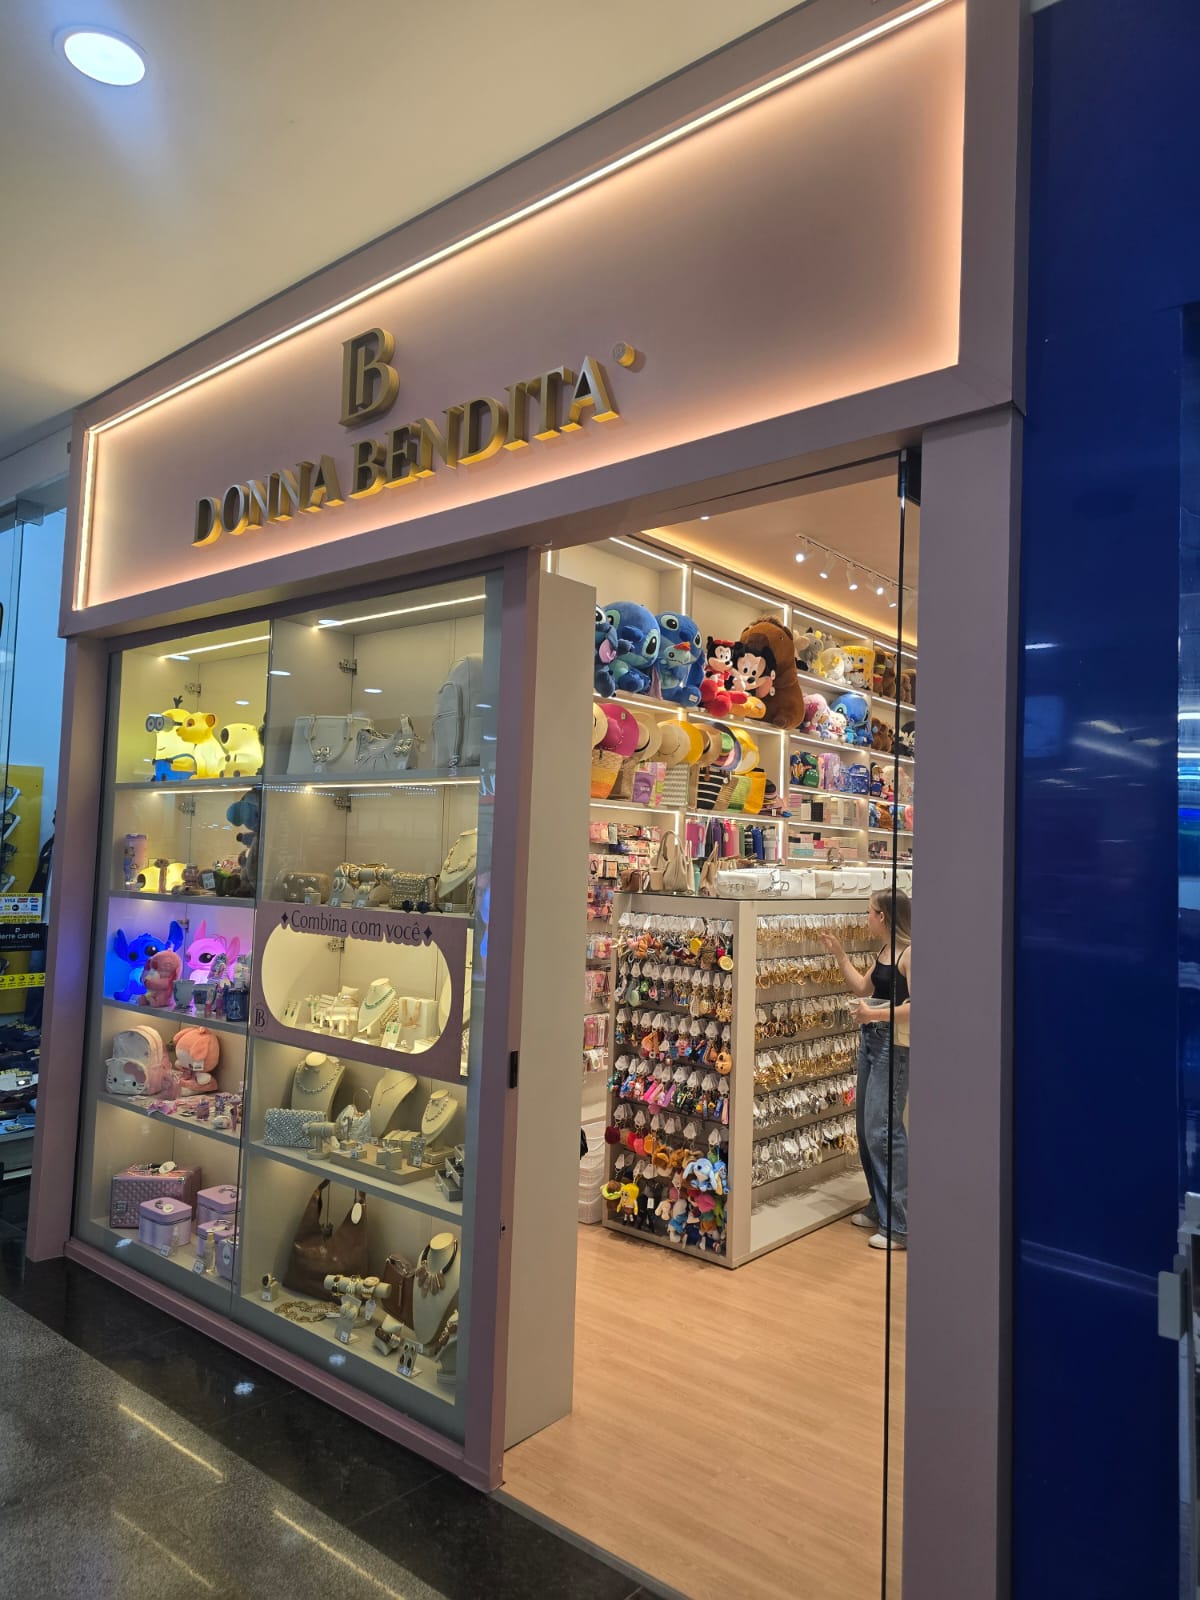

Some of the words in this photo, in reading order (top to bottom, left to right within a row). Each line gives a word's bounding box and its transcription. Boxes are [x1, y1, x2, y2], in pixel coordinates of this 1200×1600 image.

[338, 328, 400, 426] B
[192, 454, 345, 547] DONNA
[349, 355, 619, 499] BENDITA
[17, 931, 40, 939] cardin
[291, 910, 347, 933] Combina
[351, 919, 381, 937] com
[386, 922, 421, 941] você
